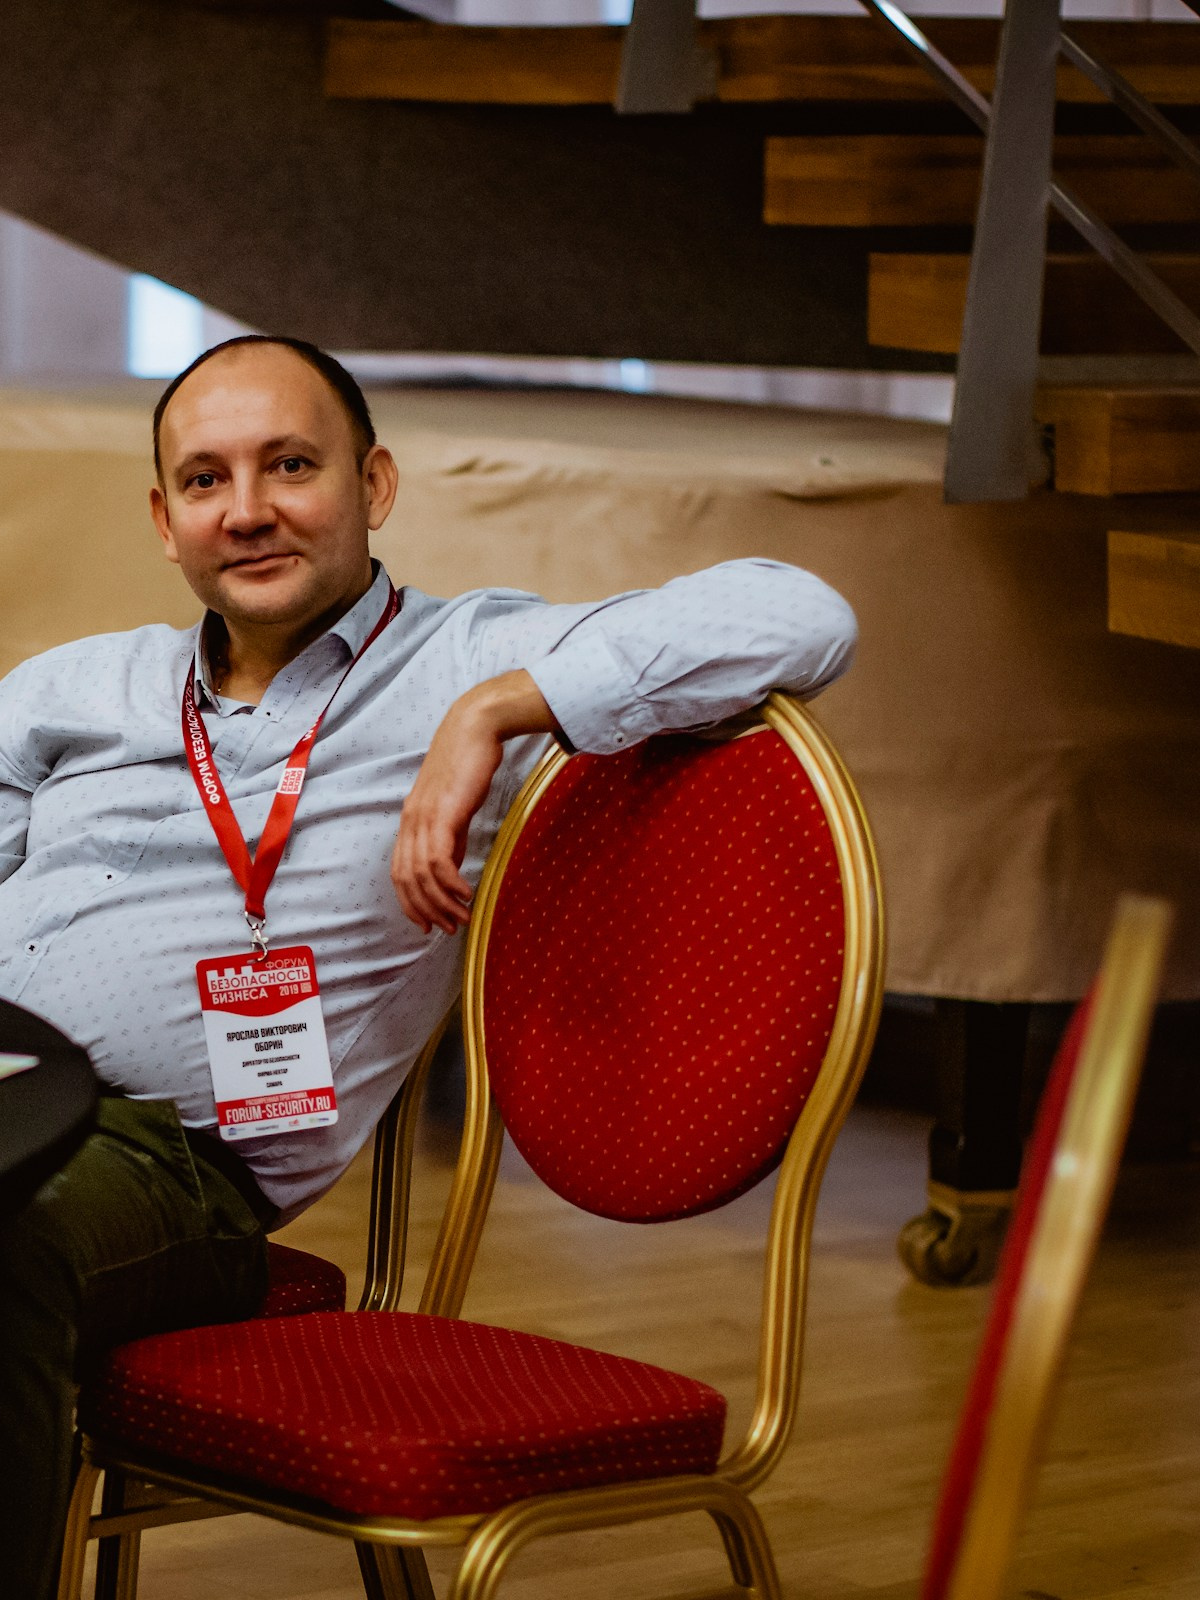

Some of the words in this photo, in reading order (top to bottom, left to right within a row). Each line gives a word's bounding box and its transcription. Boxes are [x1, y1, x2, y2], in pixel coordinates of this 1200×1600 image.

[184, 686, 207, 761] БЕЗОПАСНОСТЬ
[198, 761, 221, 805] ФОРУМ
[265, 957, 308, 971] ФОРУМ
[210, 969, 309, 991] БЕЗОПАСНОСТЬ
[212, 989, 268, 1005] БИЗНЕСА
[279, 984, 299, 997] 2019
[226, 1029, 259, 1042] ЯРОСЛАВ
[261, 1022, 307, 1038] ВИКТОРОВИЧ
[254, 1040, 283, 1052] ОБОРИН
[226, 1096, 330, 1123] FORUM-SECURITY.RU
